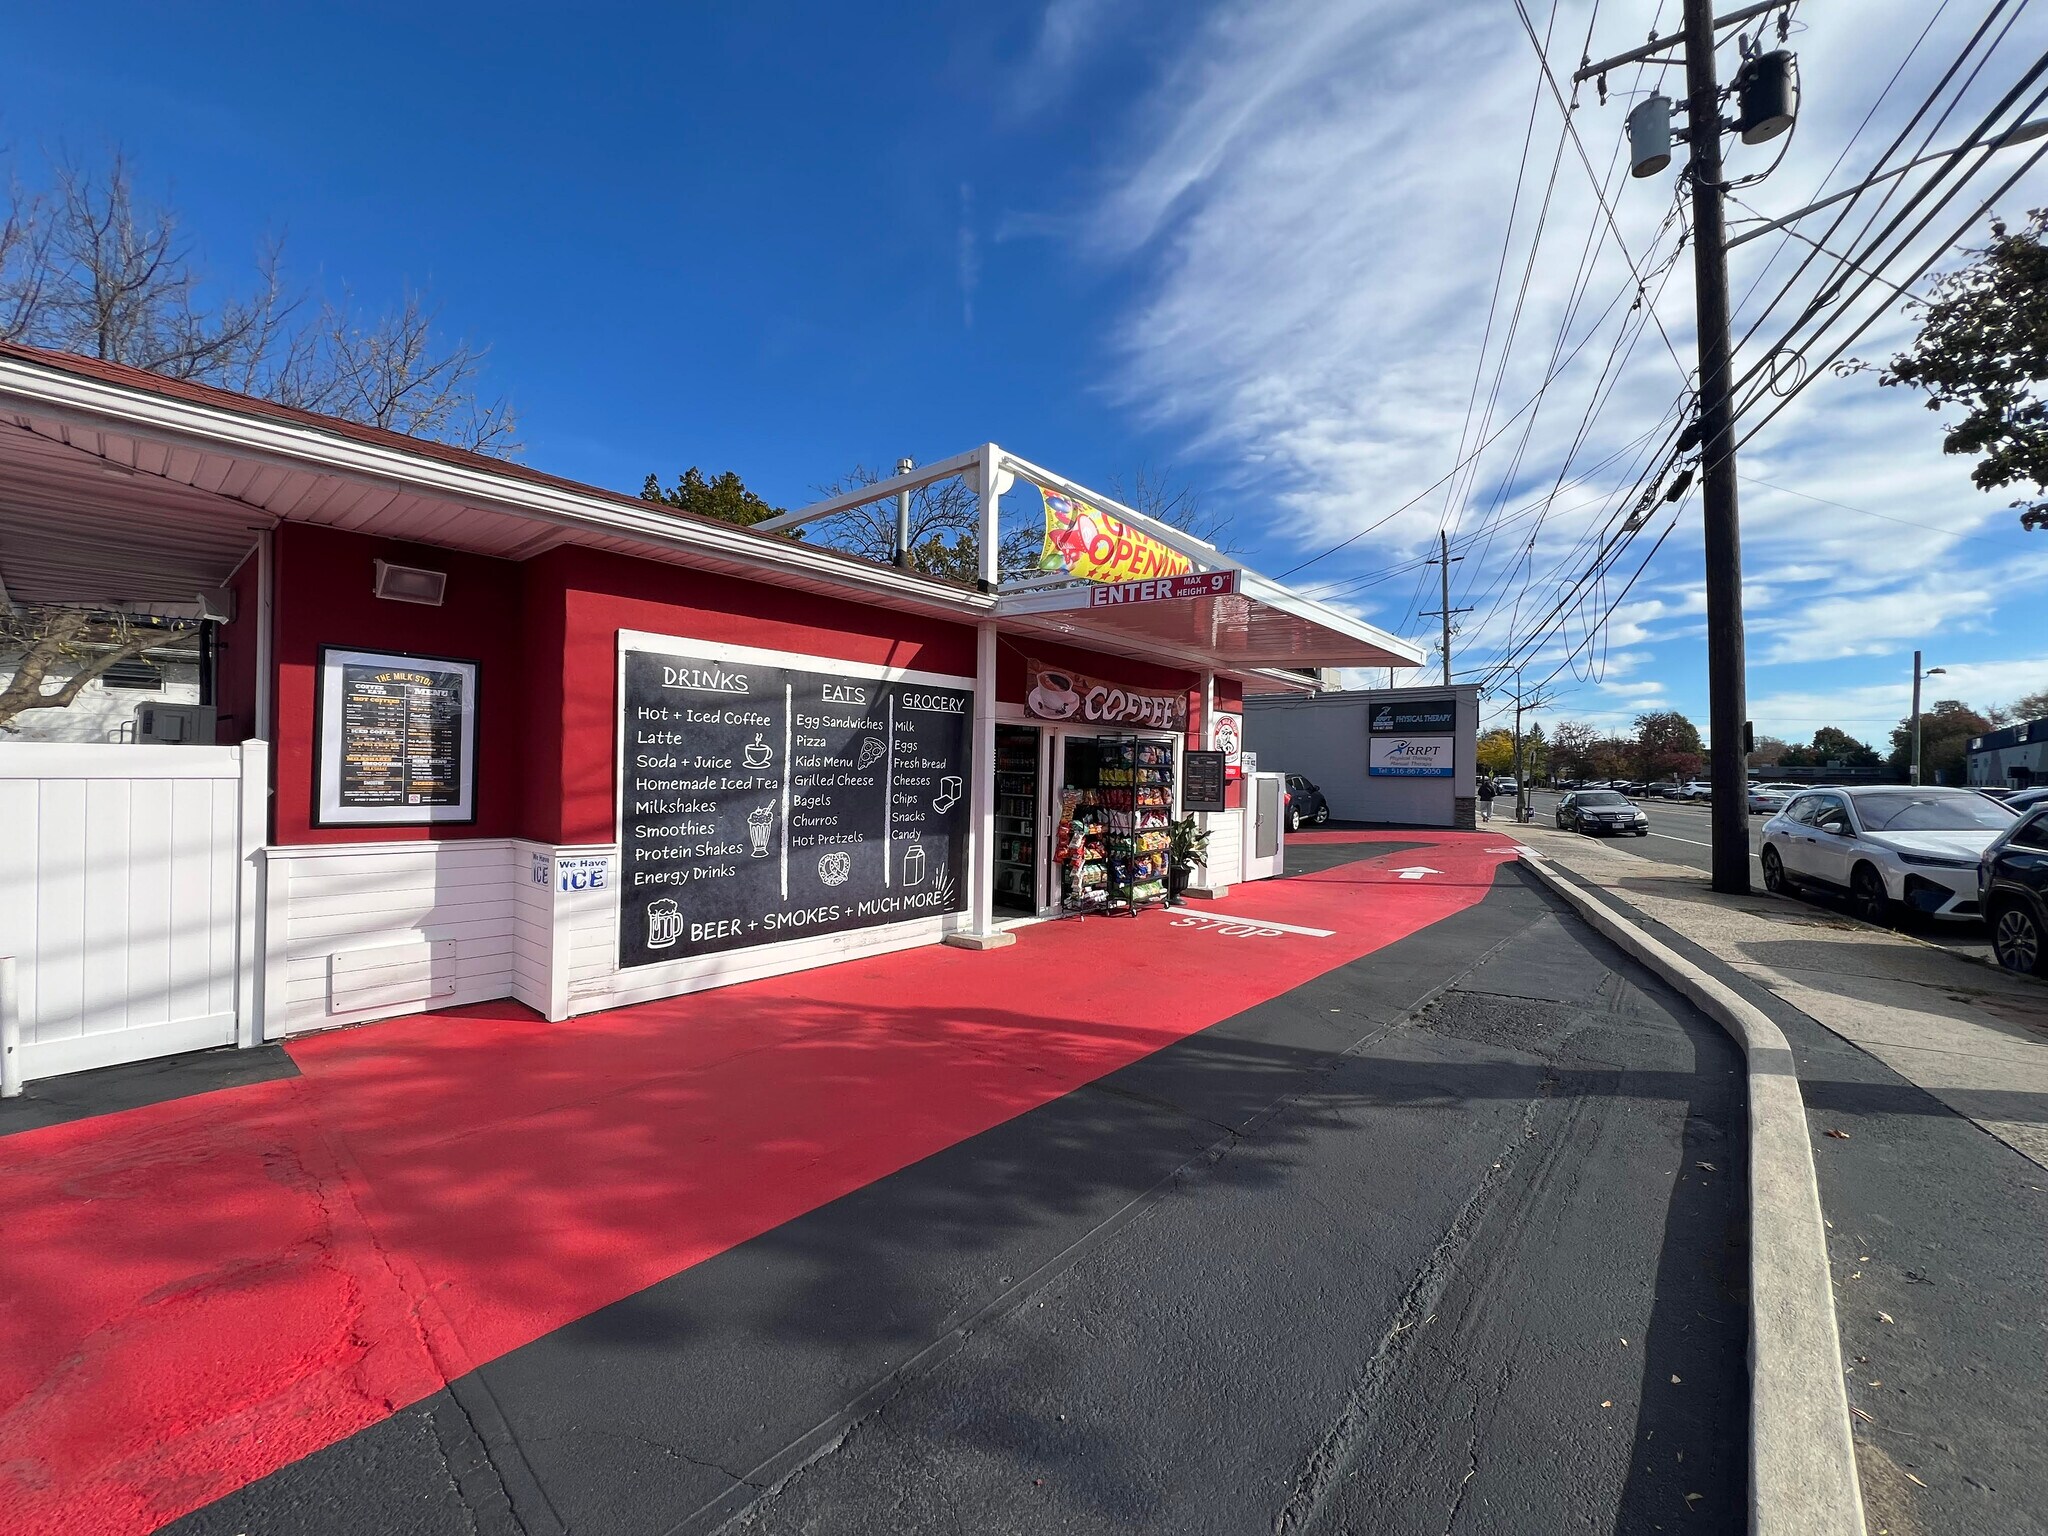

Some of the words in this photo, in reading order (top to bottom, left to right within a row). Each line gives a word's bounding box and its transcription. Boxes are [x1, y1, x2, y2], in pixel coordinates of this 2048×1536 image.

[1183, 576, 1202, 585] MAX
[1211, 575, 1223, 590] 9
[1093, 580, 1173, 606] ENTER
[1176, 586, 1207, 597] HEIGHT
[375, 673, 391, 682] THE
[393, 672, 413, 681] MILK
[415, 674, 434, 686] STOP
[663, 666, 749, 692] DRINKS
[414, 688, 448, 697] MENU
[822, 684, 866, 703] EATS
[903, 693, 965, 712] GROCERY
[1085, 685, 1175, 729] COFFEE
[638, 706, 669, 720] Hot
[673, 711, 682, 720] +
[686, 709, 721, 723] Iced
[724, 711, 771, 726] Coffee
[796, 714, 819, 729] Egg
[822, 716, 884, 730] Sandwiches
[1396, 715, 1423, 723] PHYSICAL
[1424, 714, 1451, 722] THERAPY
[895, 721, 915, 732] Milk
[637, 730, 682, 745] Latte
[796, 735, 826, 747] Pizza
[894, 740, 917, 753] Eggs
[1406, 746, 1441, 755] RRPT
[636, 753, 677, 768] Soda
[681, 758, 690, 767] +
[694, 756, 732, 768] Juice
[795, 755, 821, 768] Kids
[823, 756, 853, 768] Menu
[893, 757, 920, 769] Fresh
[921, 757, 947, 769] Bread
[636, 776, 717, 791] Homemade
[720, 776, 753, 790] Iced
[756, 777, 778, 790] Tea
[794, 773, 834, 786] Grilled
[837, 774, 874, 786] Cheese
[893, 775, 931, 786] Cheeses
[635, 798, 717, 814] Milkshakes
[793, 794, 831, 809] Bagels
[892, 793, 918, 806] Chips
[793, 813, 838, 827] Churros
[891, 811, 925, 822] Snacks
[635, 820, 715, 838] Smoothies
[891, 828, 921, 842] Candy
[792, 835, 815, 847] Hot
[818, 831, 864, 845] Pretzels
[635, 845, 692, 861] Protein
[695, 841, 743, 857] Shakes
[559, 860, 576, 868] We
[533, 866, 548, 884] ICE
[561, 868, 604, 891] ICE
[634, 870, 690, 886] Energy
[693, 863, 736, 879] Drinks
[690, 918, 743, 942] BEER
[747, 920, 759, 931] +
[763, 905, 840, 931] SMOKES
[844, 907, 854, 917] +
[858, 897, 900, 917] MUCH
[903, 890, 942, 910] MORE
[1170, 916, 1284, 938] STOP
